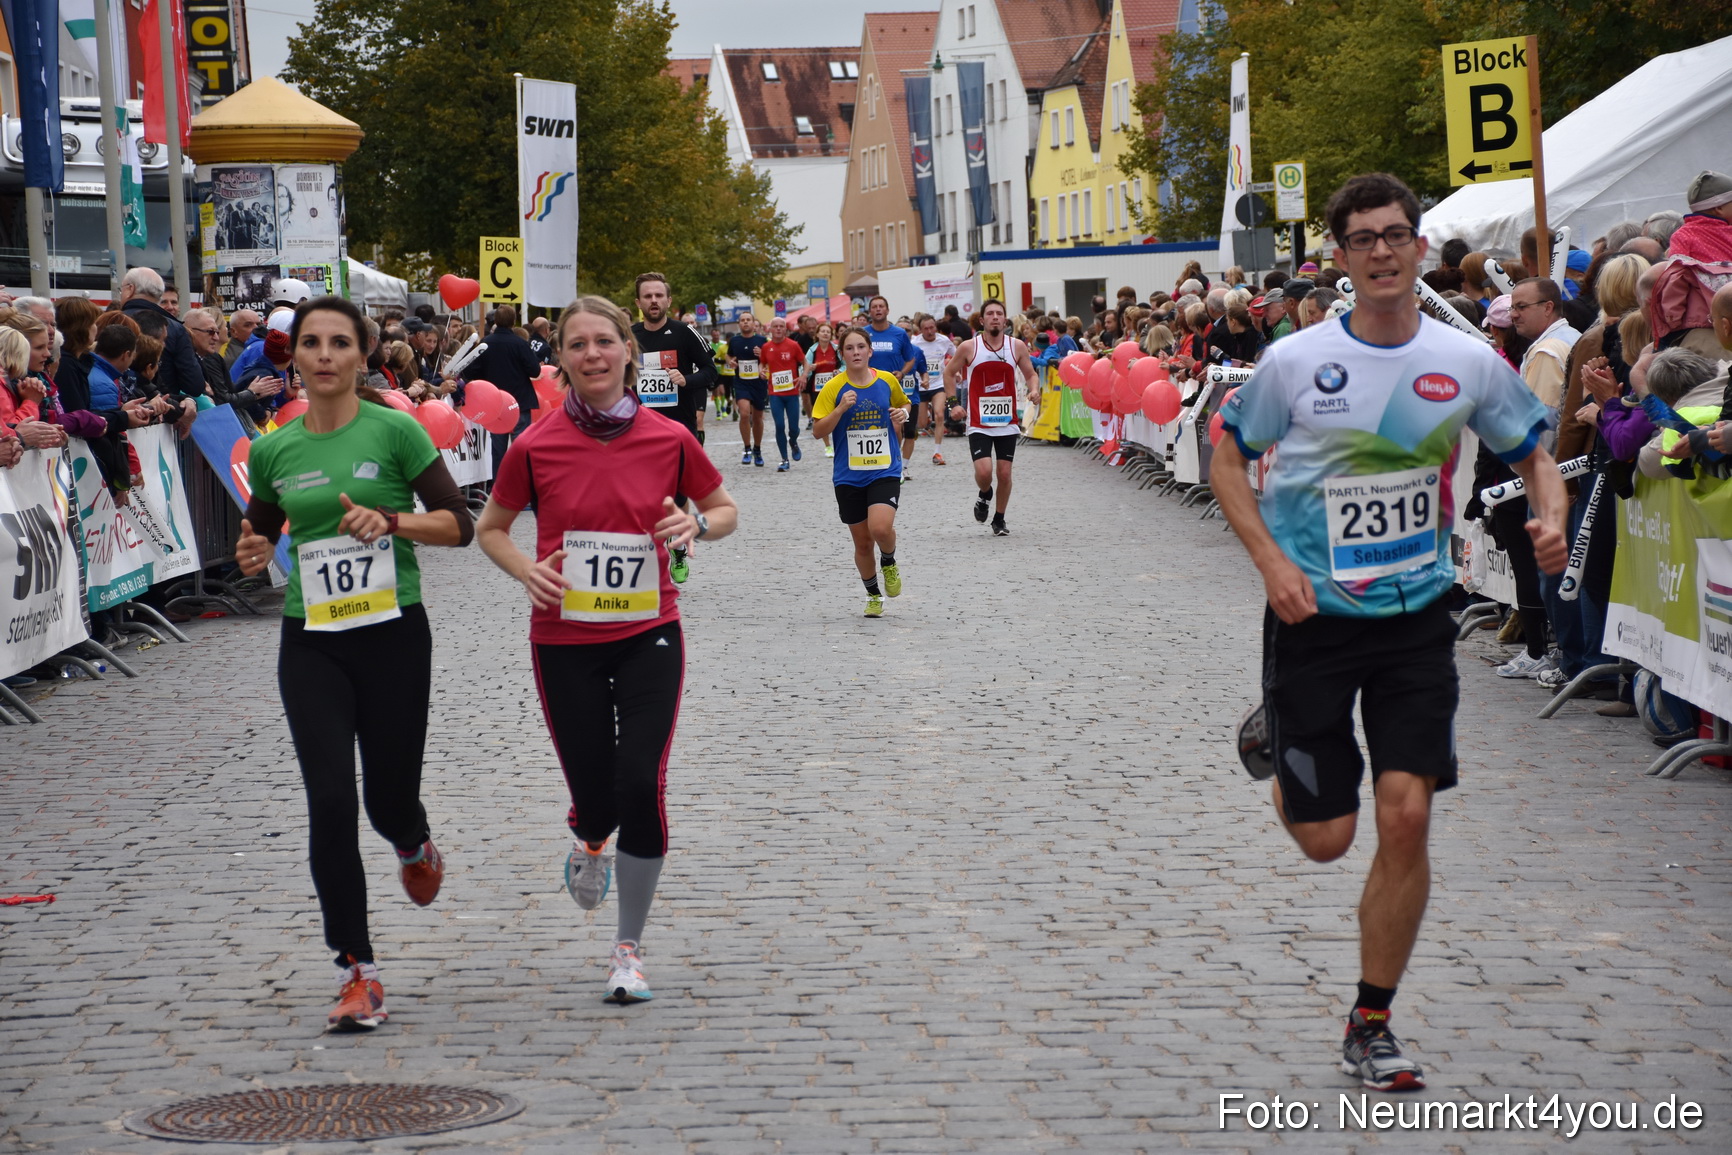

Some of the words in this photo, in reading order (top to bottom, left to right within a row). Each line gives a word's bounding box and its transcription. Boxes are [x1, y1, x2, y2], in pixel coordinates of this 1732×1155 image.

[1454, 44, 1527, 75] Block
[1469, 83, 1518, 153] B
[524, 115, 574, 138] swn
[485, 240, 519, 252] Block
[220, 275, 234, 285] MARK
[490, 256, 512, 289] C
[216, 286, 235, 296] BENDER
[987, 283, 999, 299] D
[222, 301, 235, 311] BAND
[237, 302, 266, 311] CASH
[1425, 296, 1450, 317] BMW
[641, 379, 674, 393] 2364
[776, 376, 789, 385] 308
[1228, 374, 1253, 382] BMW
[1420, 379, 1456, 395] Hervis
[983, 404, 1010, 415] 2200
[1314, 398, 1349, 409] PARTL
[1314, 407, 1350, 416] Neumarkt
[857, 439, 883, 455] 102
[1328, 486, 1367, 499] PARTL
[1371, 479, 1422, 496] Neumarkt
[1341, 491, 1430, 540] 2319
[300, 548, 327, 563] PARTL
[328, 542, 374, 557] Neumarkt
[566, 539, 599, 550] PARTL
[601, 541, 647, 552] Neumarkt
[1353, 540, 1421, 565] Sebastian
[1568, 533, 1586, 569] BMW
[317, 555, 373, 596] 187
[585, 554, 645, 589] 167
[329, 599, 370, 619] Bettina
[594, 596, 629, 610] Anika
